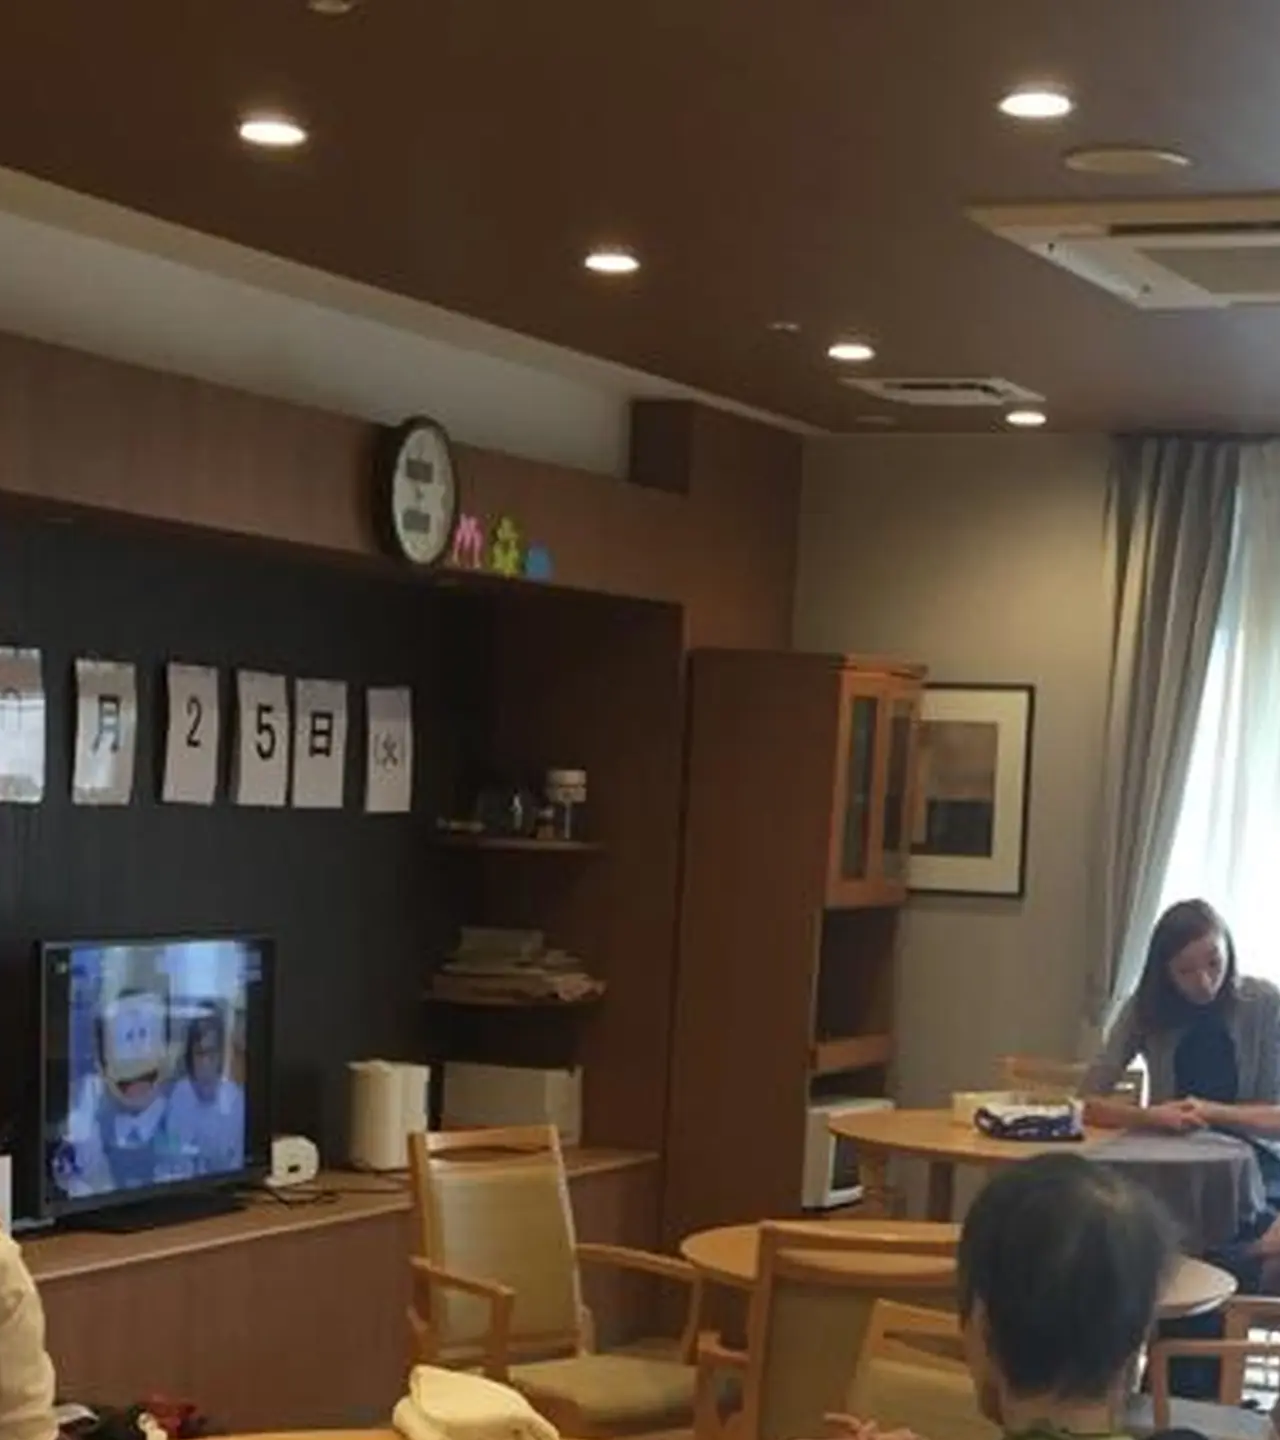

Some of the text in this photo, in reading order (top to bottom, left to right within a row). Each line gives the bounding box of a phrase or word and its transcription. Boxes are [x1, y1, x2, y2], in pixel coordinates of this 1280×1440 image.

[92, 694, 121, 755] 月
[186, 694, 203, 748] 2
[256, 703, 276, 761] 5
[309, 710, 334, 758] 日
